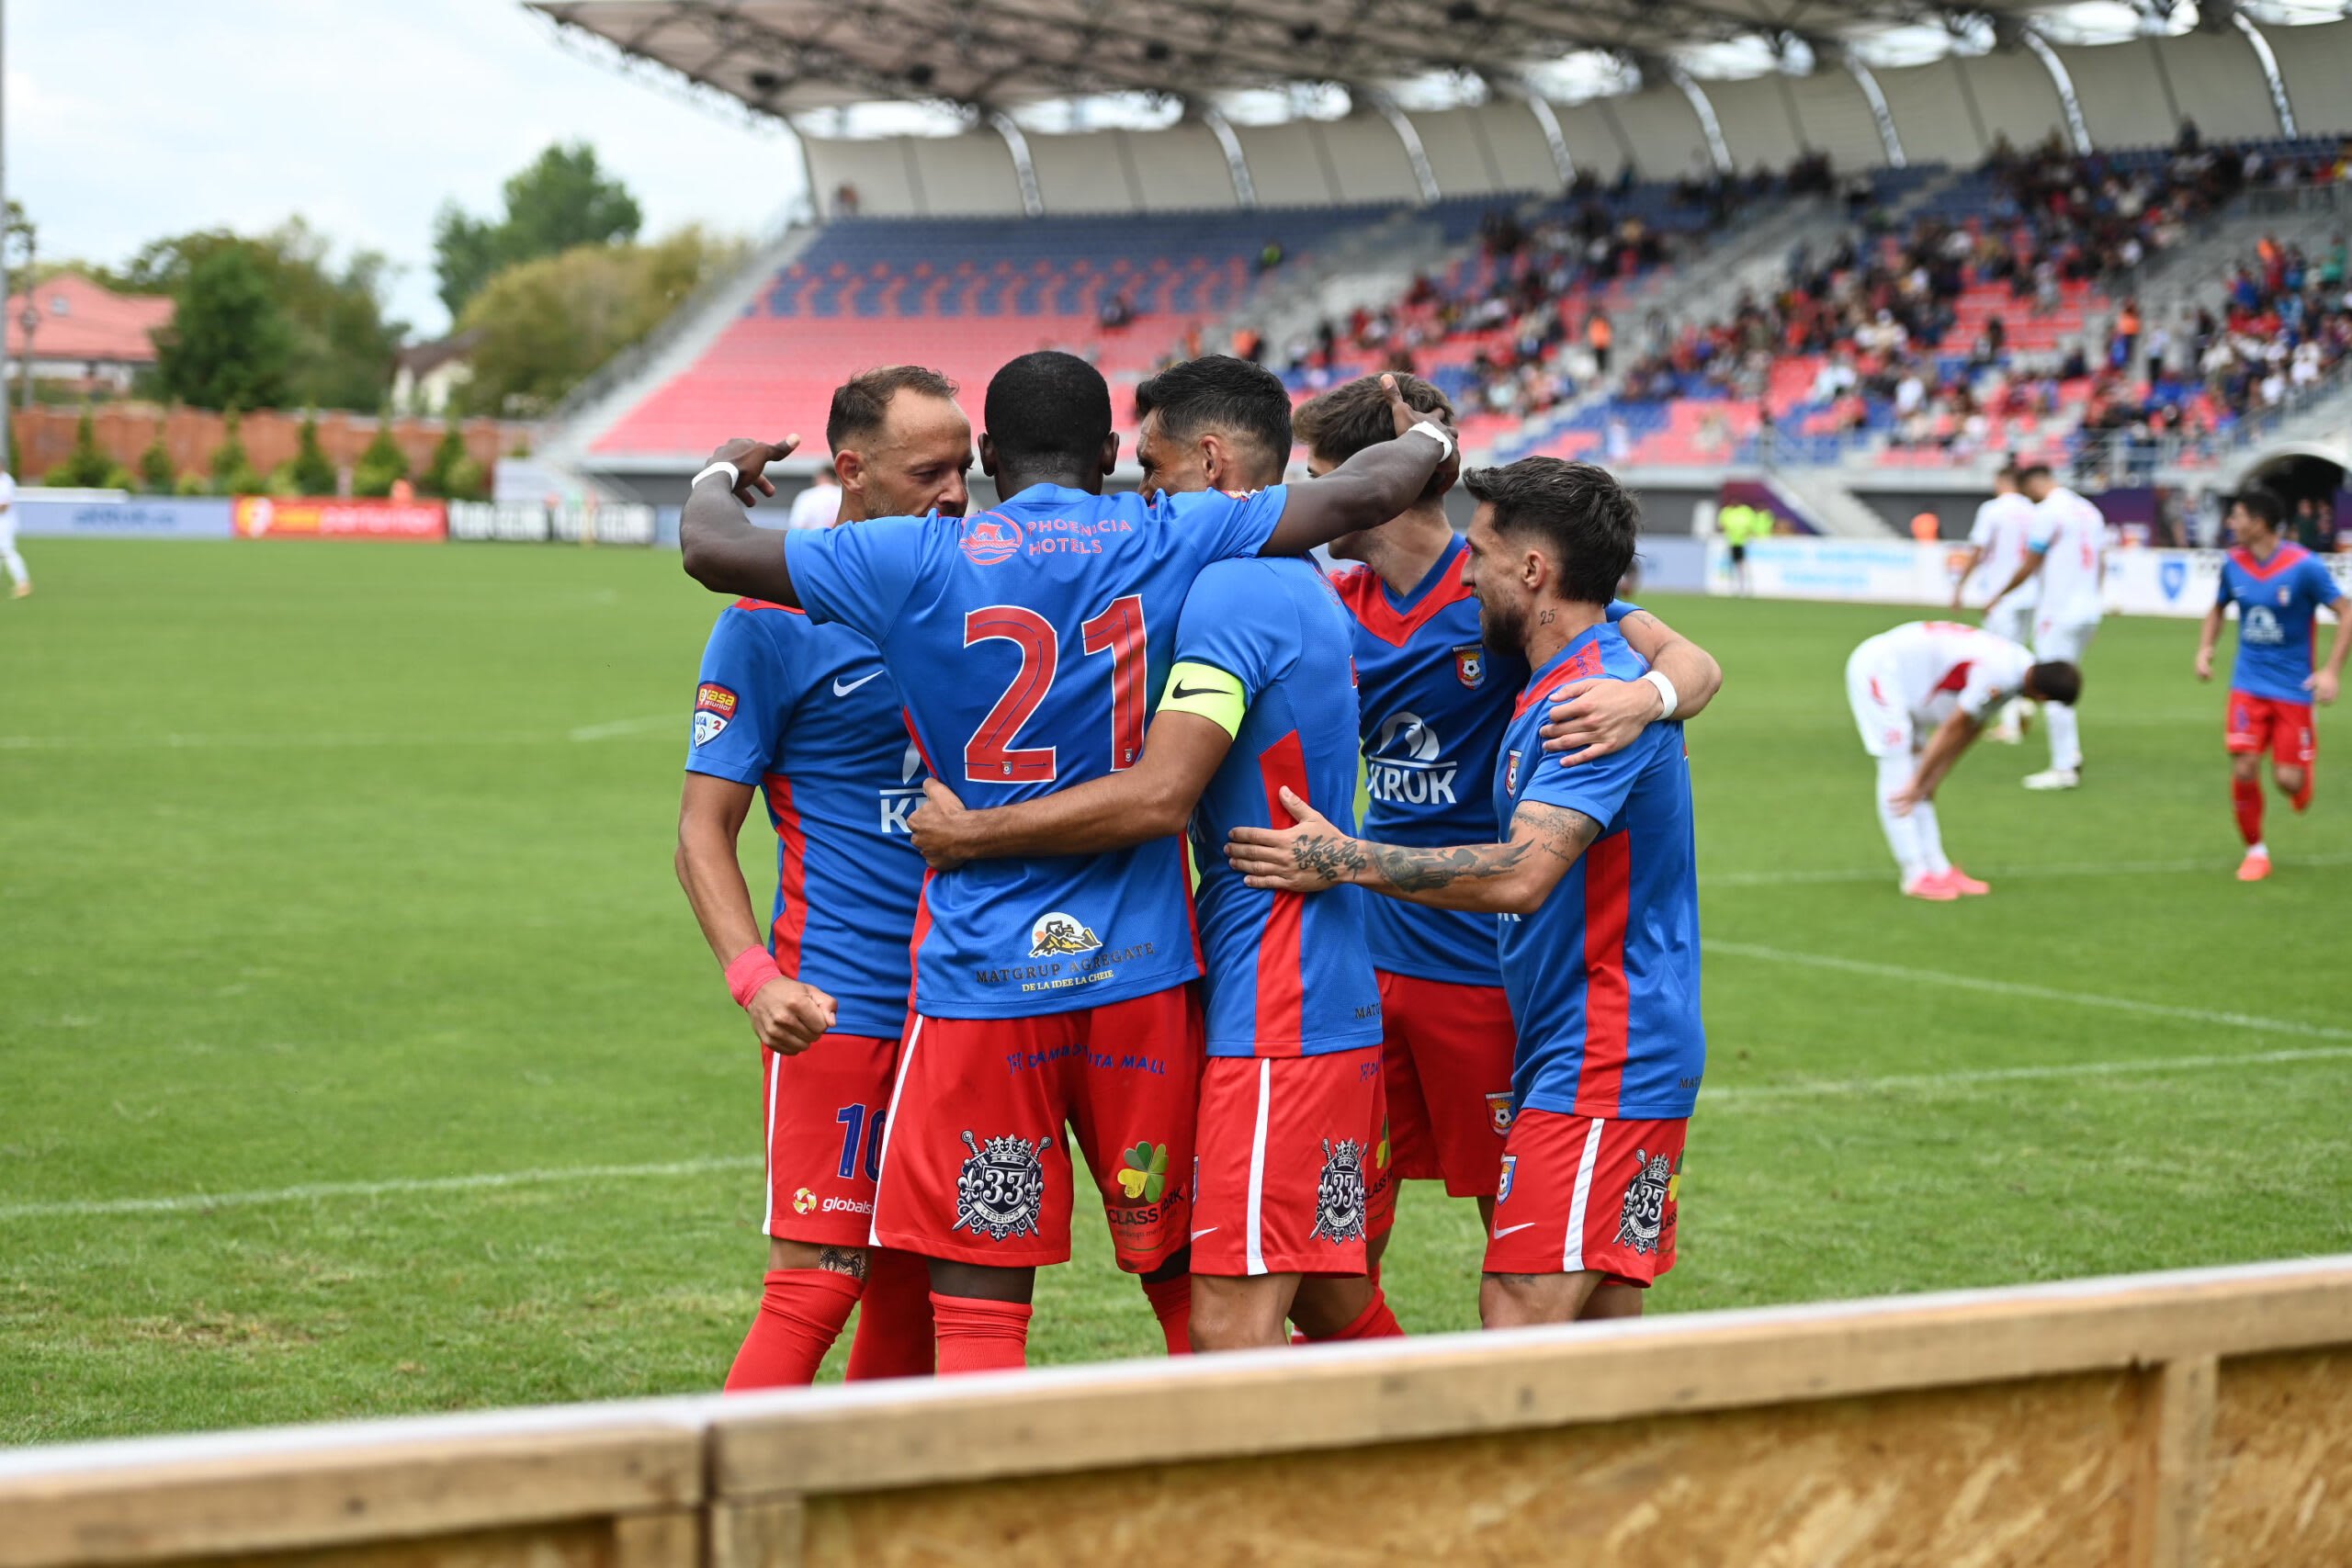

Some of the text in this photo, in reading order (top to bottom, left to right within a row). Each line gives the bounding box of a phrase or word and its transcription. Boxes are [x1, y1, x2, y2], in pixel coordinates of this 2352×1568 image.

[1025, 518, 1133, 536] PHOENICIA
[1029, 537, 1102, 556] HOTELS
[1540, 608, 1556, 626] 25
[964, 593, 1148, 784] 21
[1366, 763, 1458, 805] KRUK
[976, 942, 1156, 984] MATGRUP AGREGATE
[1022, 969, 1114, 992] DE LA IDEE LA CHEIE
[1121, 1054, 1167, 1075] MALL
[836, 1102, 887, 1183] 10
[982, 1168, 1026, 1206] 33
[1331, 1173, 1355, 1209] 33
[1635, 1185, 1665, 1223] 33
[1108, 1208, 1159, 1225] CLASS
